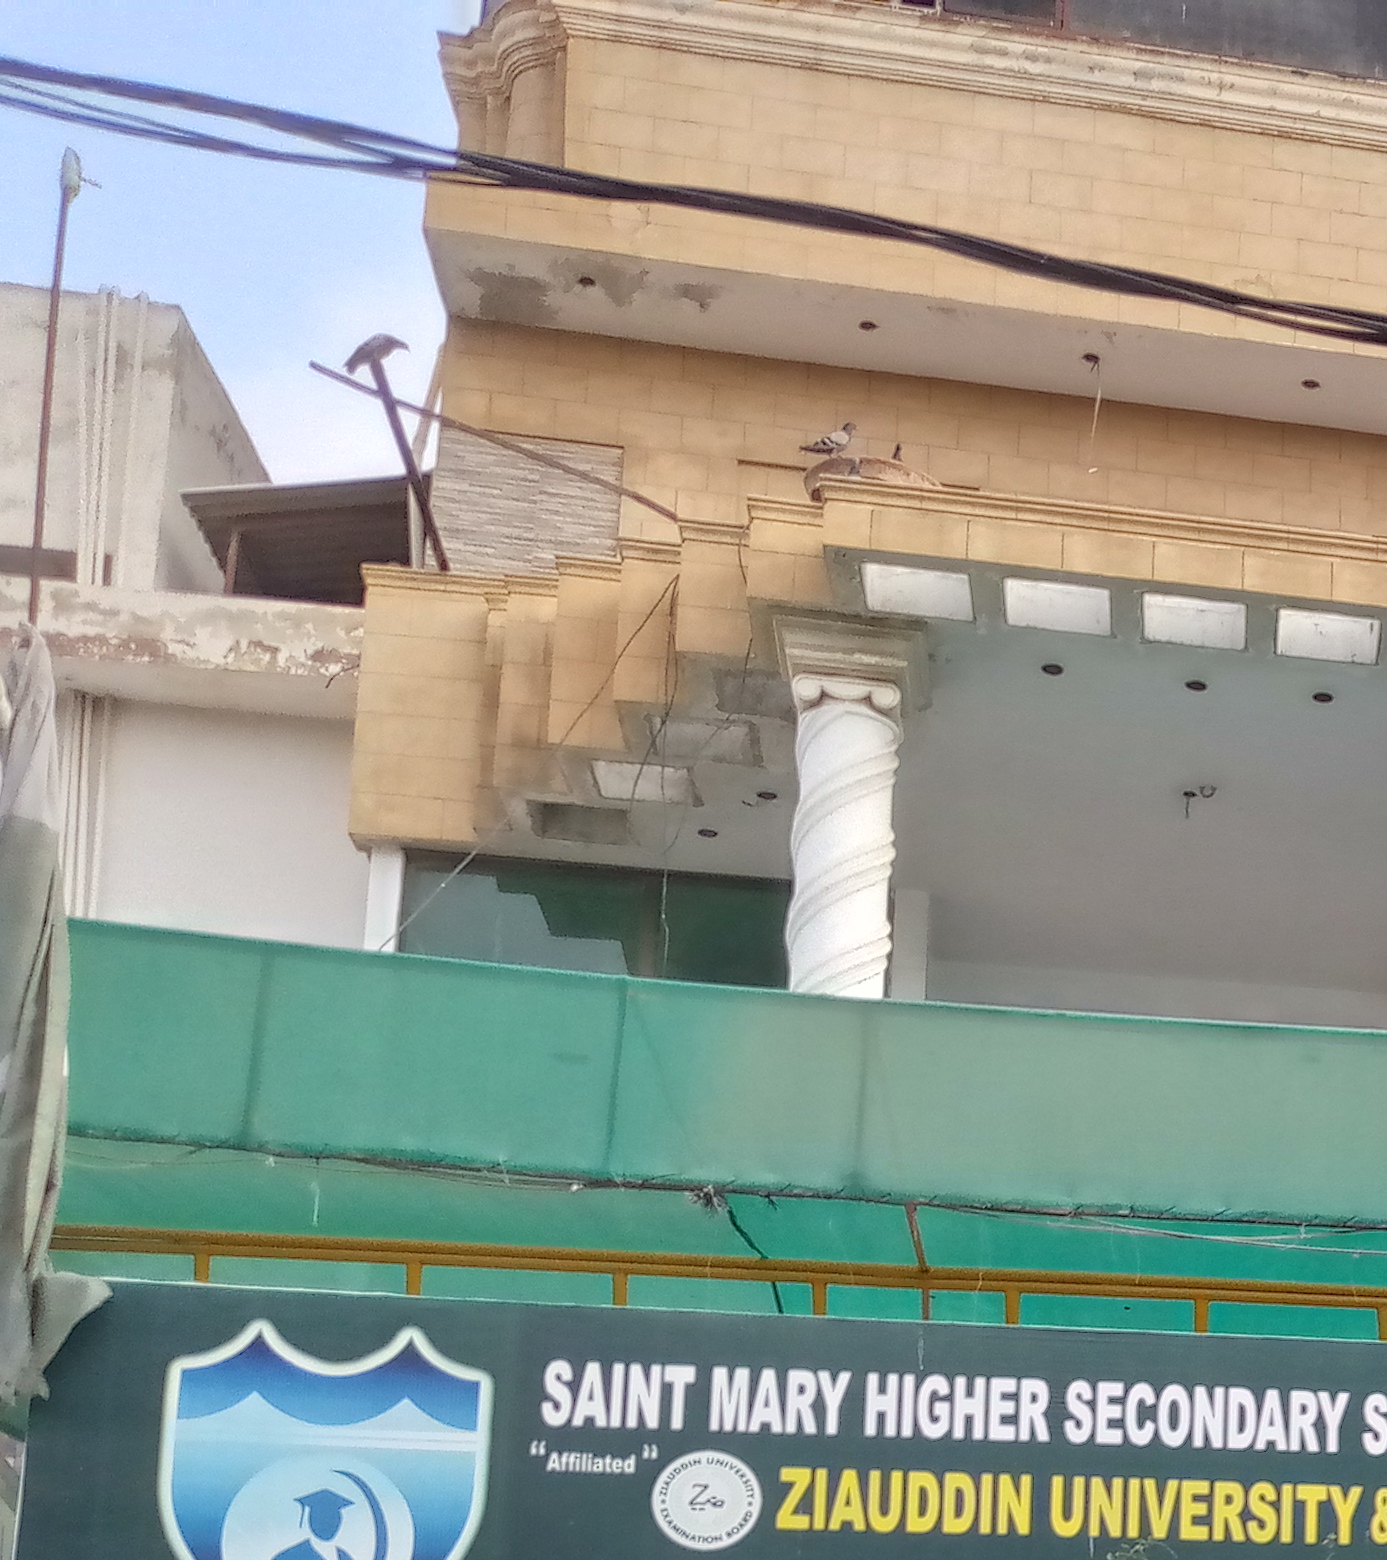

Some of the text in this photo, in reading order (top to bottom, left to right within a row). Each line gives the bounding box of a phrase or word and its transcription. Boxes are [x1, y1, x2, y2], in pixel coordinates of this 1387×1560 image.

[541, 1359, 697, 1430] SAINT
[709, 1366, 852, 1436] MARY
[864, 1372, 1050, 1443] HIGHER
[1063, 1379, 1350, 1453] SECONDARY
[659, 1456, 756, 1499] ZIAUDDIN UNIVERSITY
[775, 1467, 1032, 1536] ZIAUDDIN
[1050, 1473, 1365, 1546] UNIVERSITY
[660, 1508, 753, 1544] EXAMINATION BOARD
